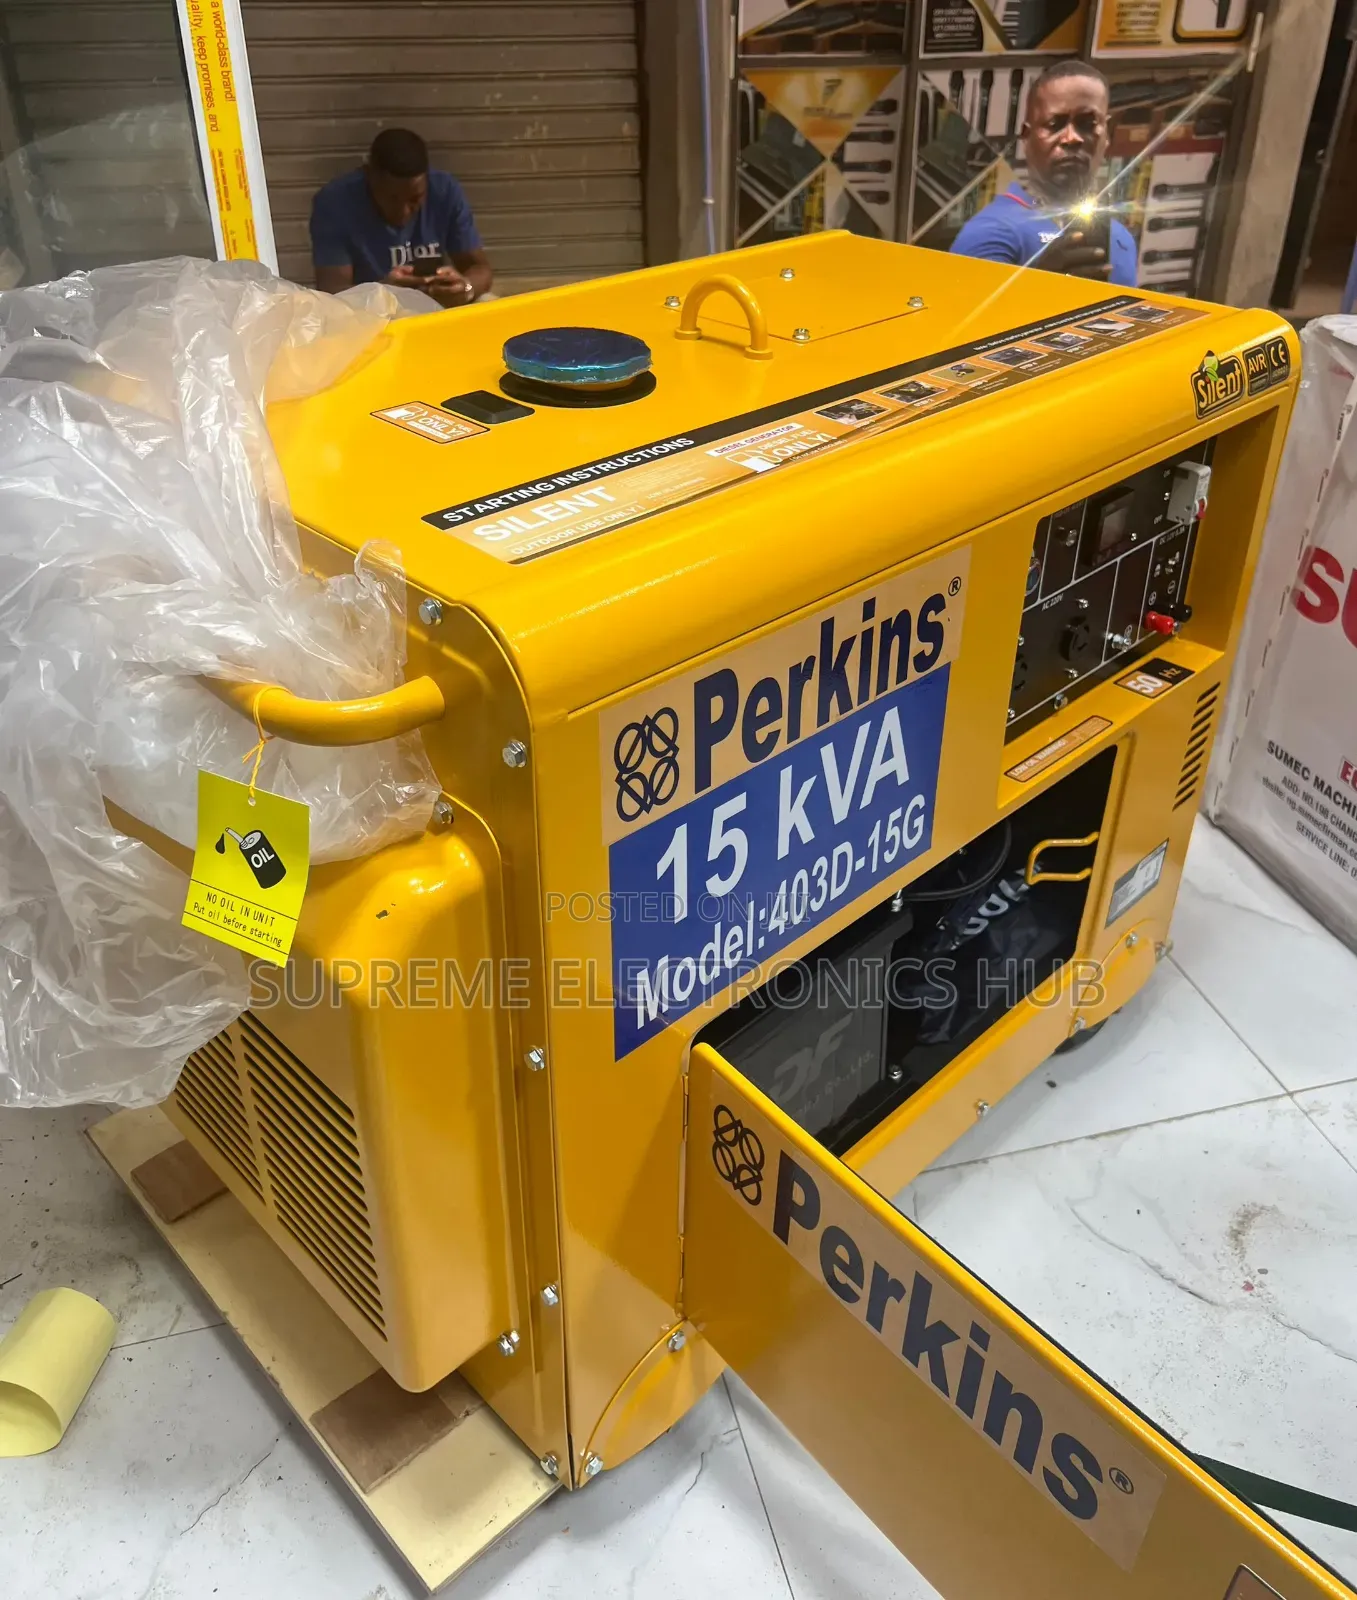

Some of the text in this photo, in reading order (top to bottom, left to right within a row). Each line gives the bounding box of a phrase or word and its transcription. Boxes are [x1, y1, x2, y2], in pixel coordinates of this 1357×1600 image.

[197, 35, 208, 61] keep
[212, 11, 229, 67] world-class
[221, 70, 236, 102] brand!
[198, 63, 216, 111] promises,
[209, 114, 220, 132] and
[390, 241, 442, 267] Dior
[1248, 353, 1267, 375] AVR
[1197, 362, 1240, 409] Silent
[418, 417, 466, 436] ONLY!
[766, 433, 837, 464] ONLY!
[442, 482, 555, 523] STARTING
[551, 437, 695, 487] INSTRUCTIONS
[472, 486, 617, 542] SILENT
[510, 530, 575, 556] OUTDOOR
[576, 518, 605, 533] USE
[694, 591, 947, 796] Perkins
[1126, 675, 1163, 693] 50
[1158, 667, 1181, 679] Hz
[1266, 740, 1357, 822] SUMEC MACHI
[656, 705, 910, 925] 15 kVA
[250, 847, 275, 869] OIL
[1296, 820, 1329, 856] SERVICE
[1329, 847, 1350, 873] LINE:
[193, 902, 283, 947] Put oil before starting
[206, 891, 275, 927] NO OIL IN UNIT
[771, 1148, 1102, 1521] Perkins
